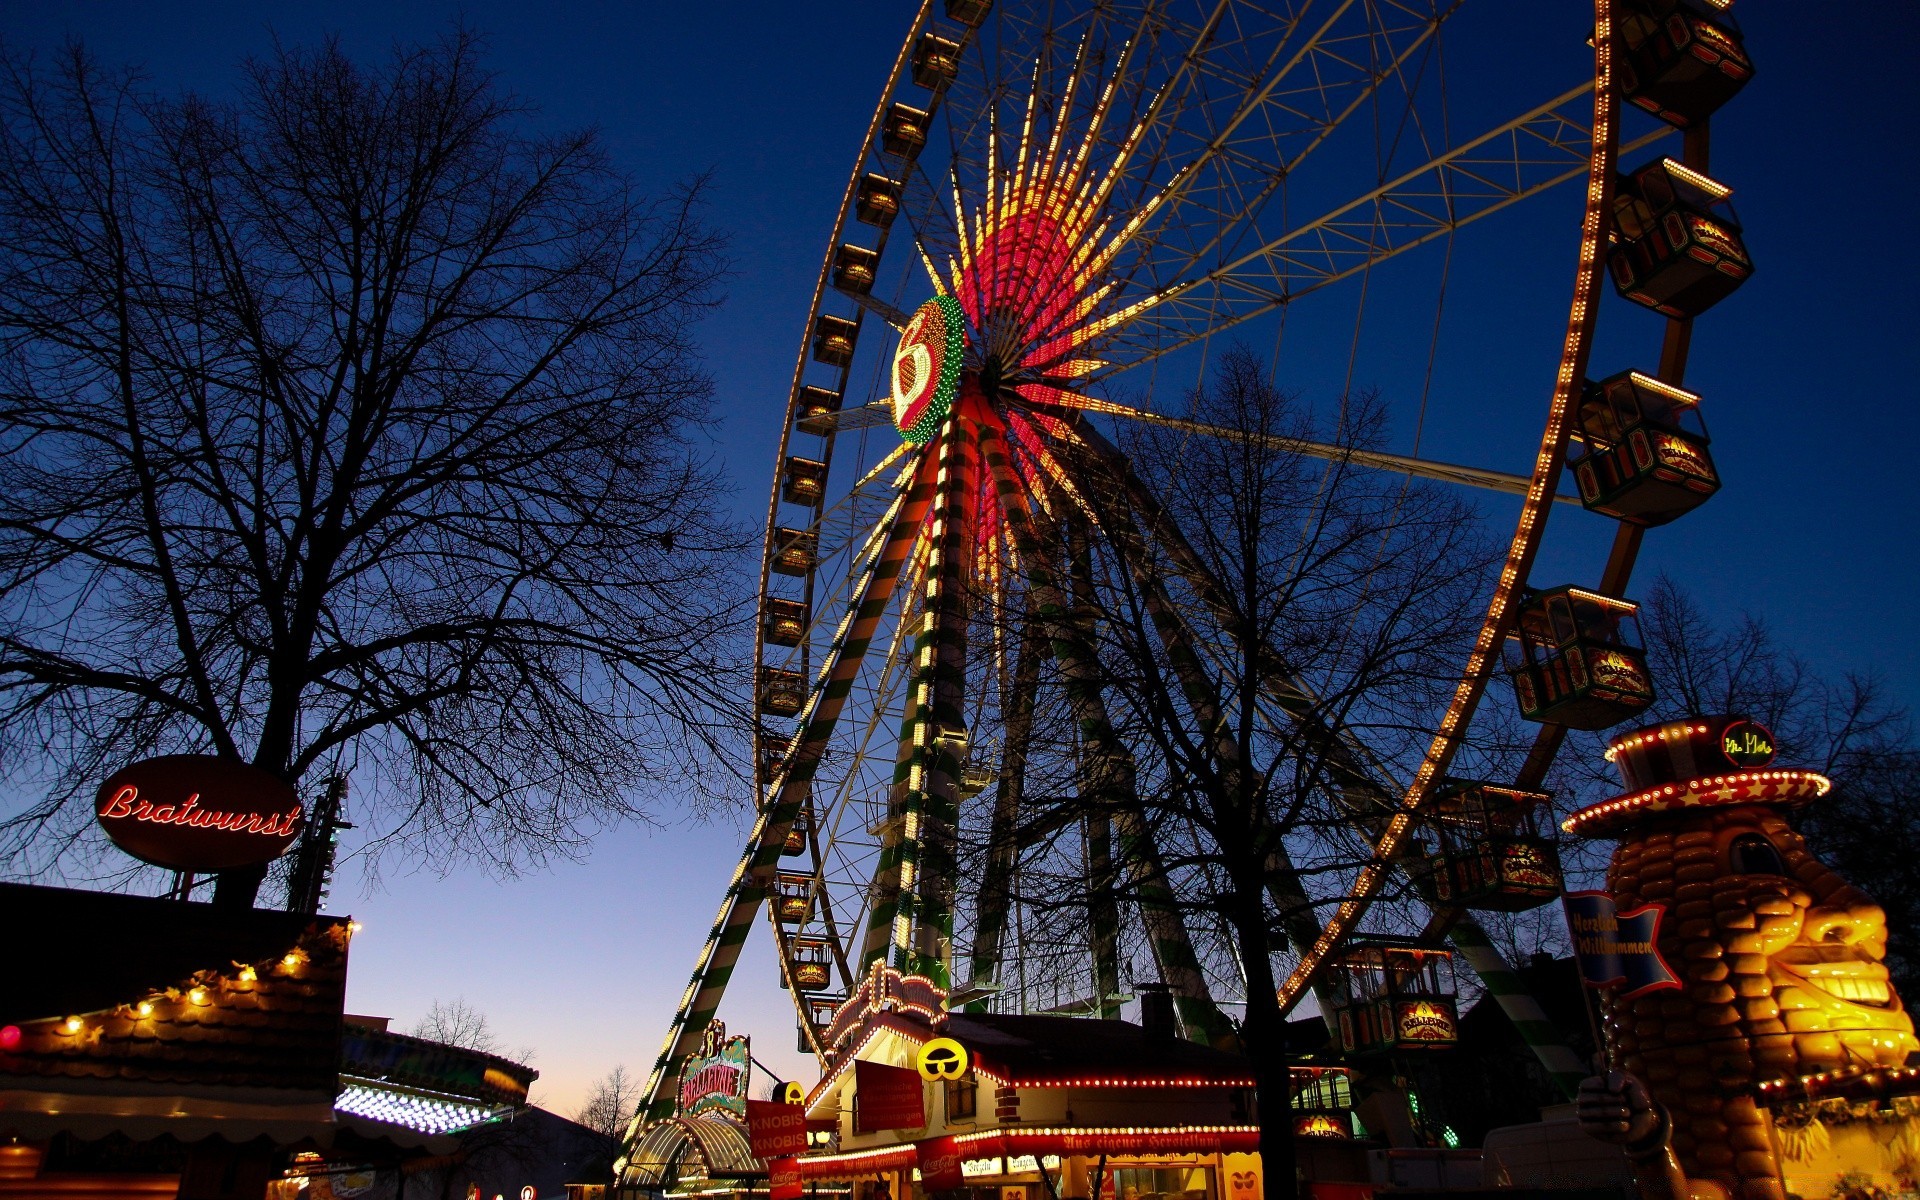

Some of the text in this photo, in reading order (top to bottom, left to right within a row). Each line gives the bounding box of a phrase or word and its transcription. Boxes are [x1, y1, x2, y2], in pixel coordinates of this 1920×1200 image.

[99, 784, 302, 837] Bratwurst
[1573, 912, 1619, 933] Herzlich
[1578, 936, 1653, 955] Willkommen
[1421, 1004, 1428, 1015] 8
[1403, 1016, 1450, 1033] BELLEVUE
[683, 1065, 735, 1109] BELLEVUE
[752, 1113, 804, 1131] KNOBIS
[753, 1133, 805, 1151] KNOBIS
[1063, 1134, 1221, 1152] Aus eigener Herstellung
